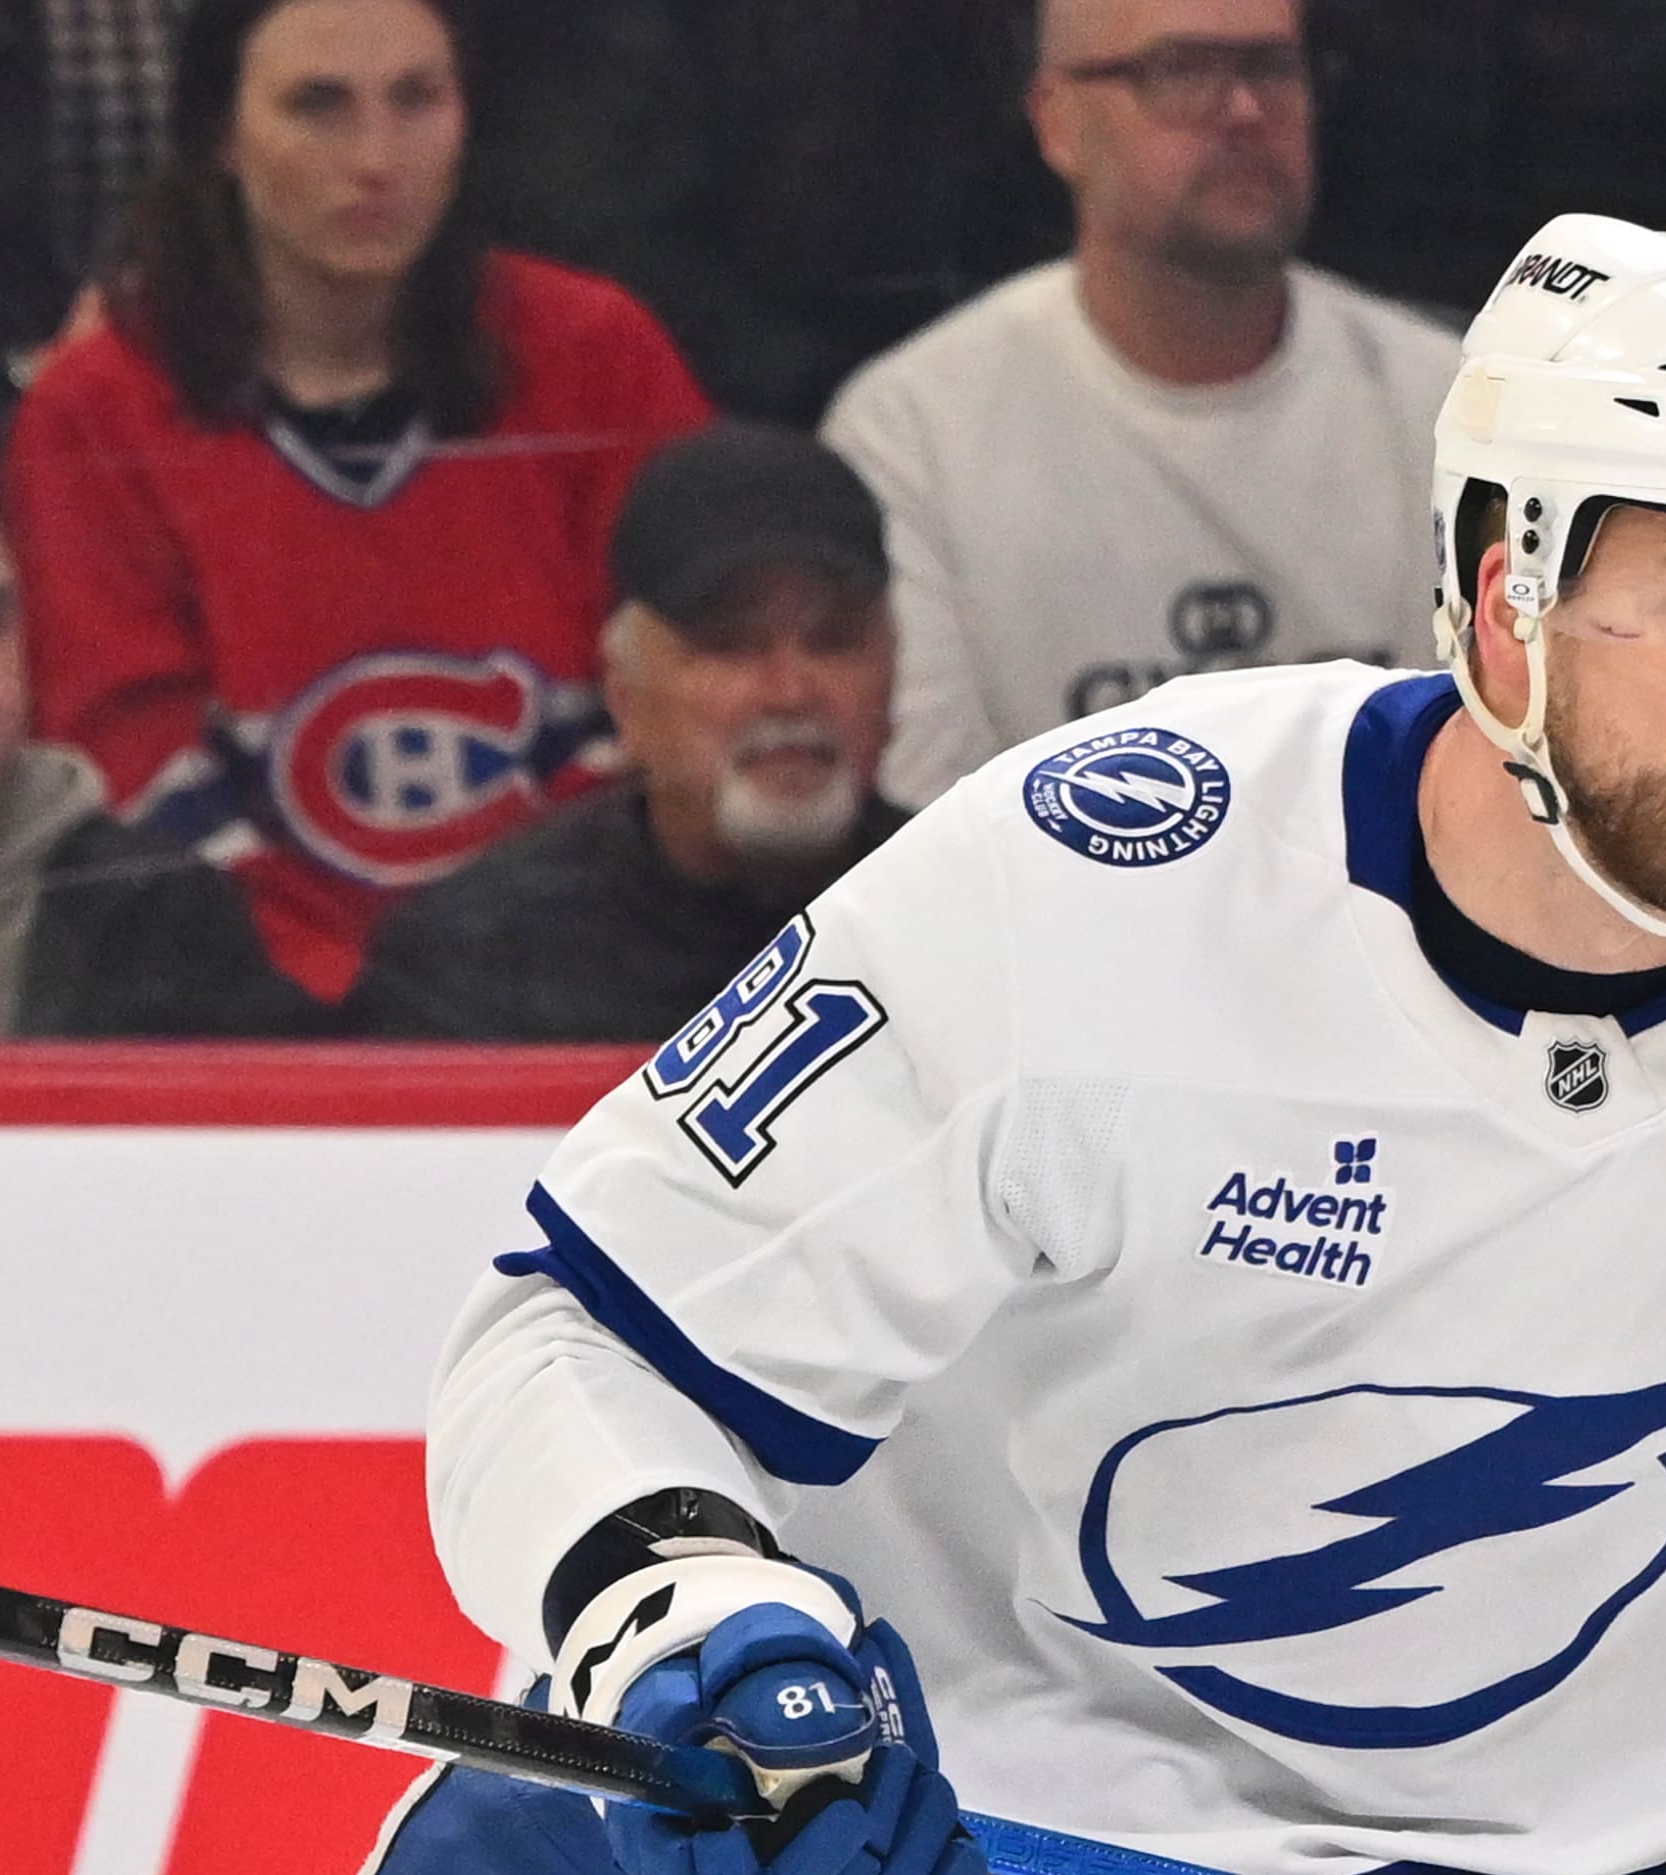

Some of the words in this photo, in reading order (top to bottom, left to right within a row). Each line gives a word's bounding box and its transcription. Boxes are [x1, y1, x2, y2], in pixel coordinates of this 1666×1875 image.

[1053, 731, 1159, 764] TAMPA
[1167, 739, 1220, 772] BAY
[1087, 780, 1225, 861] LIGHTNING
[642, 912, 889, 1190] 81
[1558, 1059, 1598, 1097] NHL
[1207, 1172, 1387, 1235] Advent
[1200, 1220, 1372, 1286] Health
[57, 1607, 414, 1740] CCM
[776, 1681, 836, 1720] 81
[873, 1665, 906, 1744] CC
